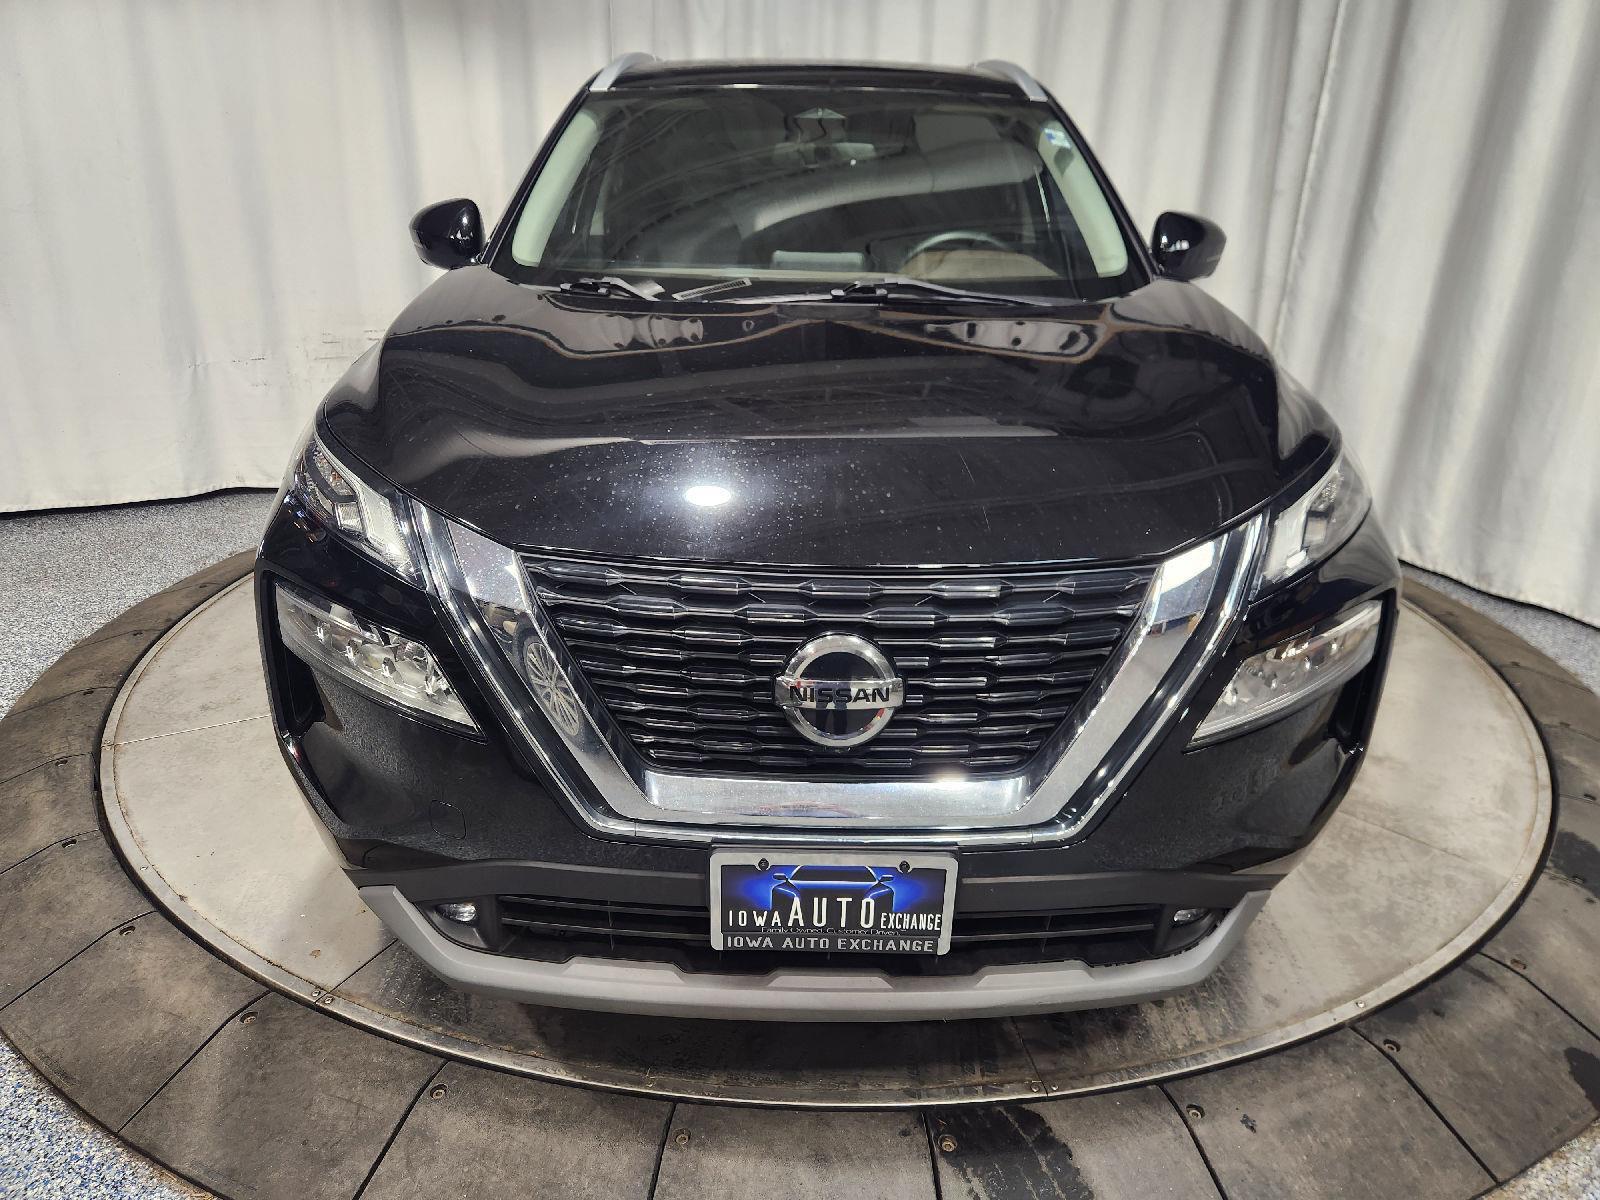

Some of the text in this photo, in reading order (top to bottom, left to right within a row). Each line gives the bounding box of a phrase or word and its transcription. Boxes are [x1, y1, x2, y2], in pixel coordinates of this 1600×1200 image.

[789, 687, 890, 703] NISSAN
[728, 897, 941, 931] IOWA AUTO EXCHANGE
[727, 936, 935, 952] IOWA AUTO EXCHANGE
